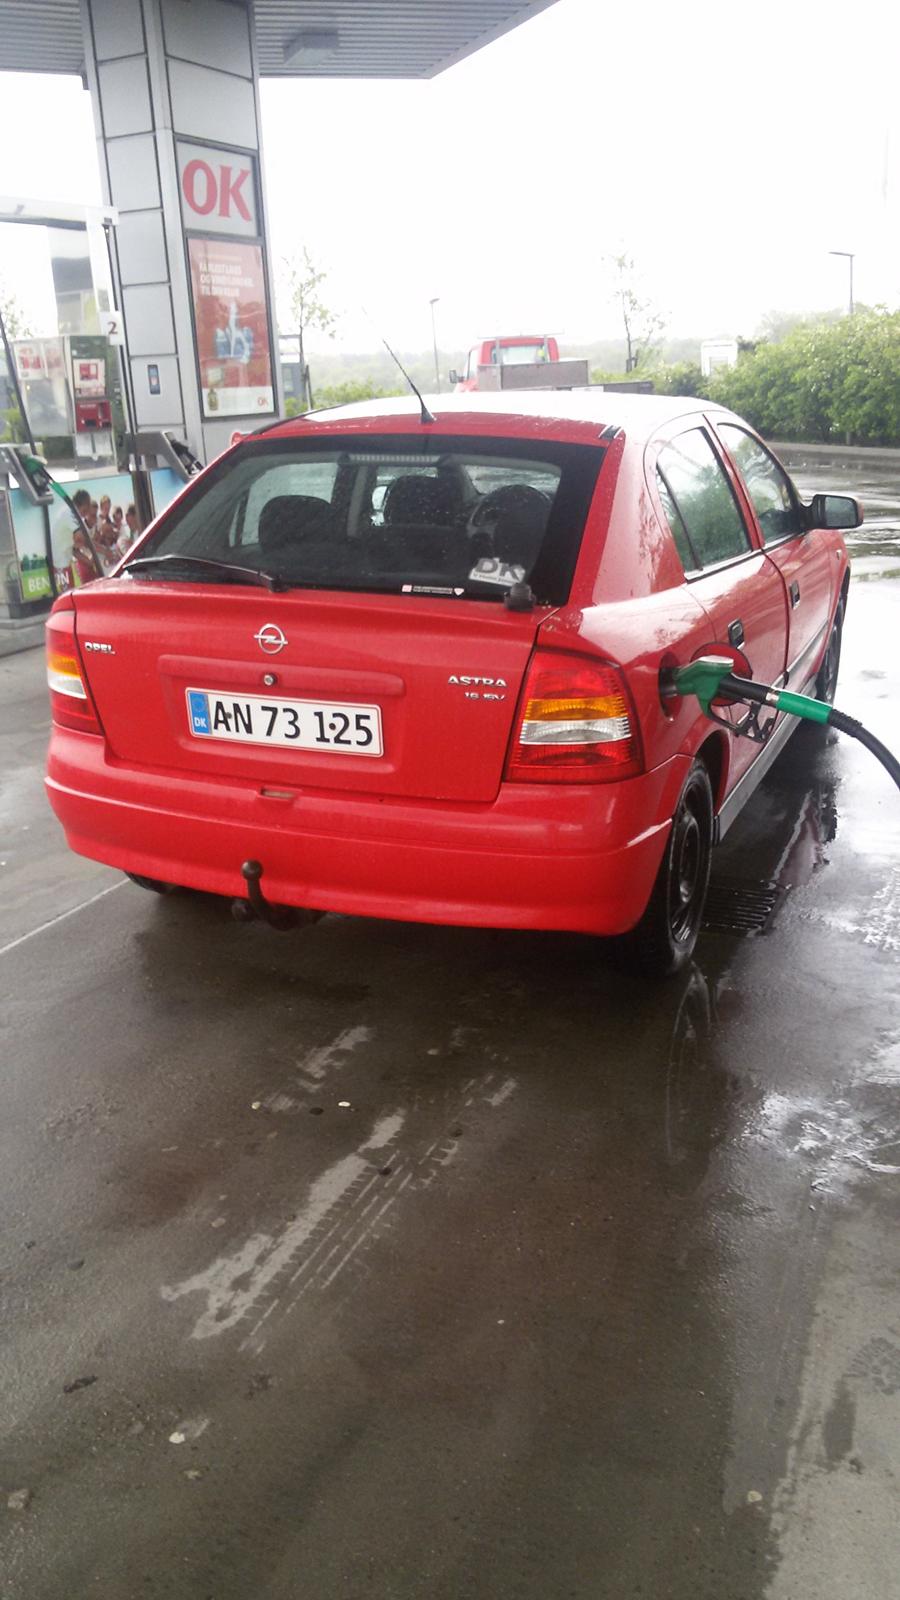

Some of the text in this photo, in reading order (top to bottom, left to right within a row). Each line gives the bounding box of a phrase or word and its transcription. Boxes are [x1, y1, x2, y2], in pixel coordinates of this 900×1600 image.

[182, 158, 252, 222] OK
[107, 321, 118, 335] 2
[475, 558, 523, 582] DK
[28, 571, 69, 593] BENIN
[84, 641, 116, 655] OPEL
[448, 675, 507, 688] ASTRA
[193, 716, 208, 729] DK
[213, 701, 373, 746] AN 73 125
